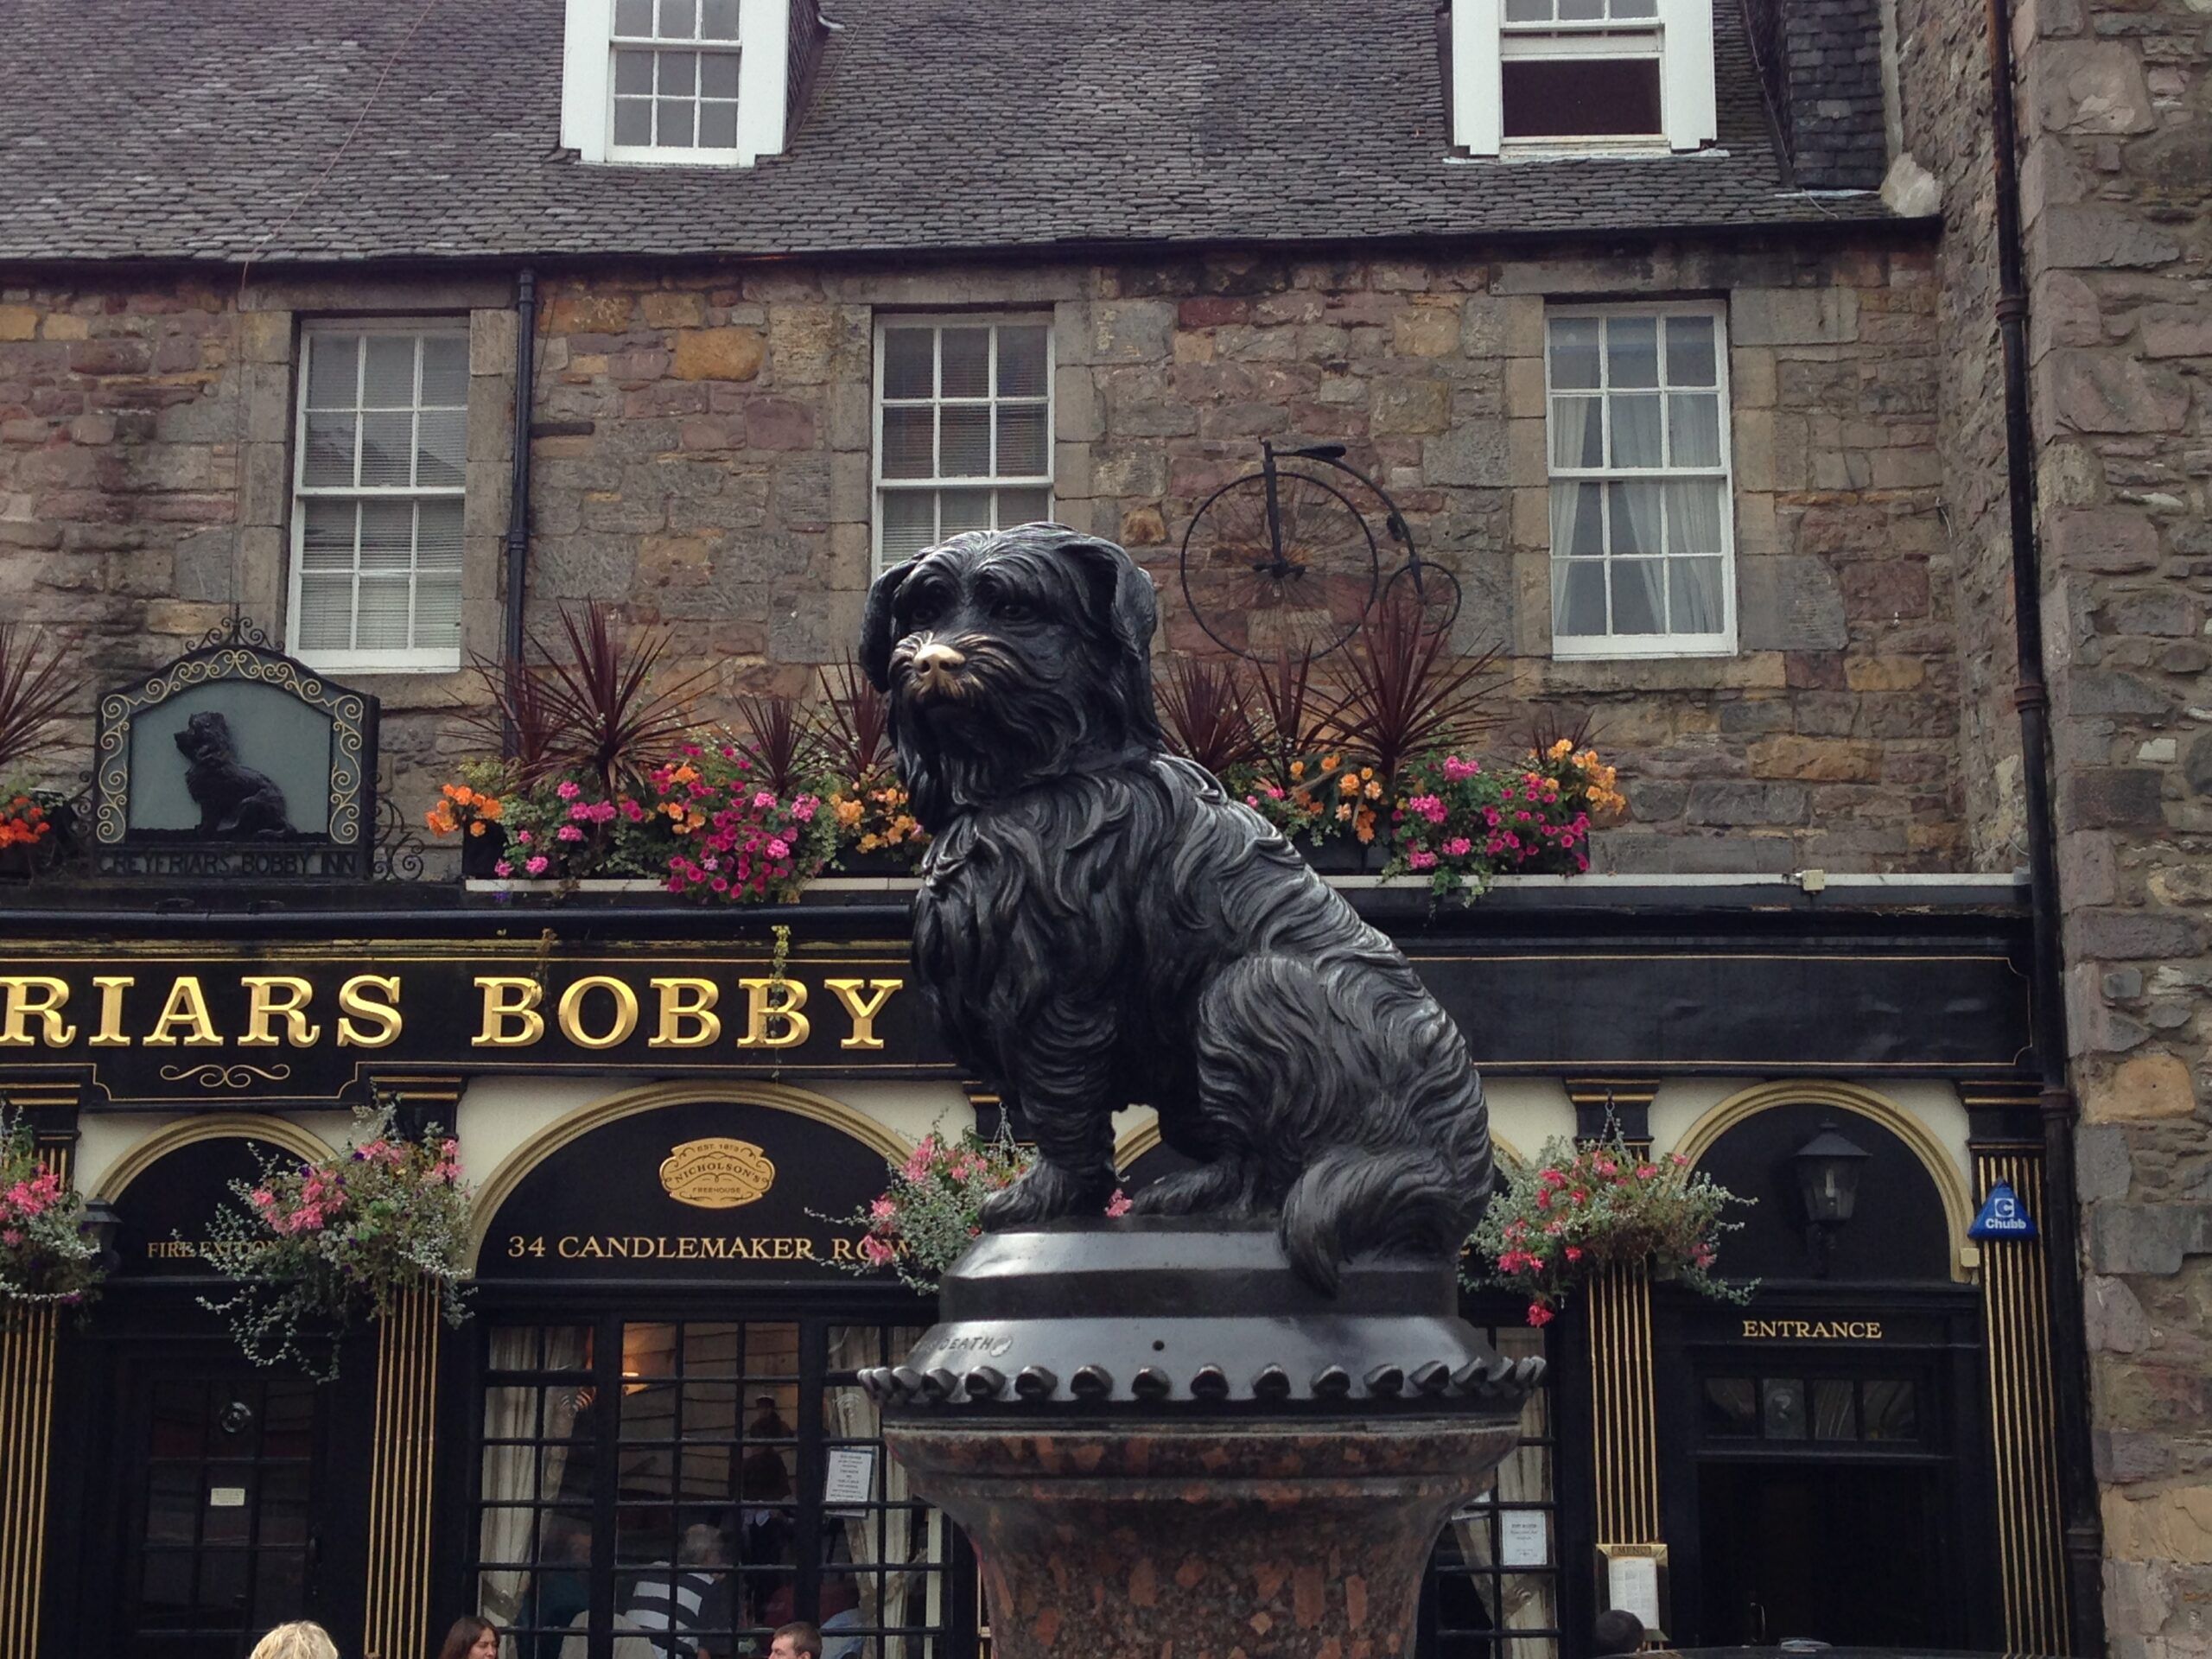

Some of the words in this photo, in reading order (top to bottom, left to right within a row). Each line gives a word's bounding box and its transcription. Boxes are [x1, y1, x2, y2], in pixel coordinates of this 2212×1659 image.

[241, 853, 310, 874] BOBBY
[322, 853, 357, 874] INN
[0, 976, 404, 1048] RIARS
[471, 976, 904, 1049] BOBBY
[674, 1162, 760, 1183] NICHOLSON'S
[1985, 1217, 2027, 1230] Chubb
[147, 1241, 195, 1258] FIRE
[507, 1236, 546, 1258] 34
[558, 1236, 816, 1261] CANDLEMAKER
[1742, 1320, 1883, 1338] ENTRANCE
